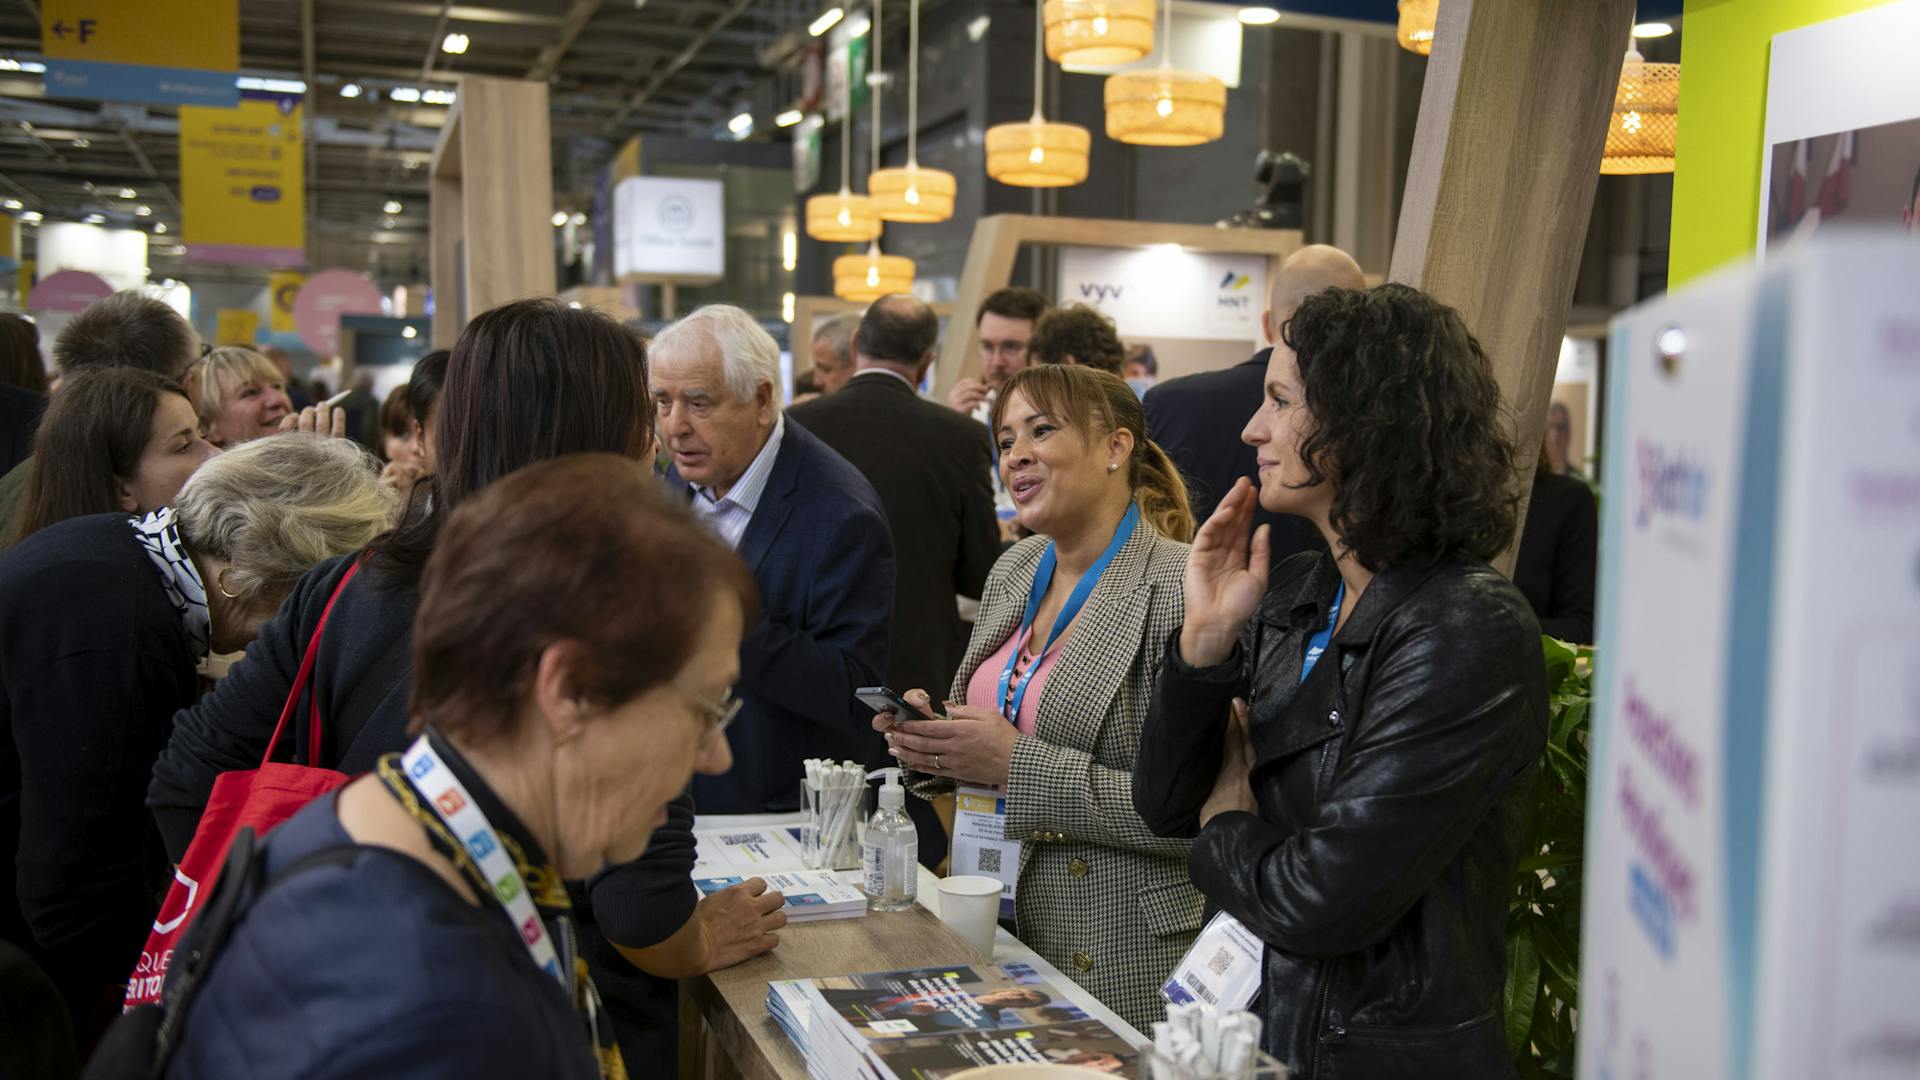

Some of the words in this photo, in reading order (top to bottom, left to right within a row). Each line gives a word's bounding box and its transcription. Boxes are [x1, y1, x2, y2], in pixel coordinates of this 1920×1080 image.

[79, 19, 96, 43] F
[1080, 283, 1122, 303] vyv
[1218, 297, 1249, 307] MNT
[136, 950, 173, 973] QUE
